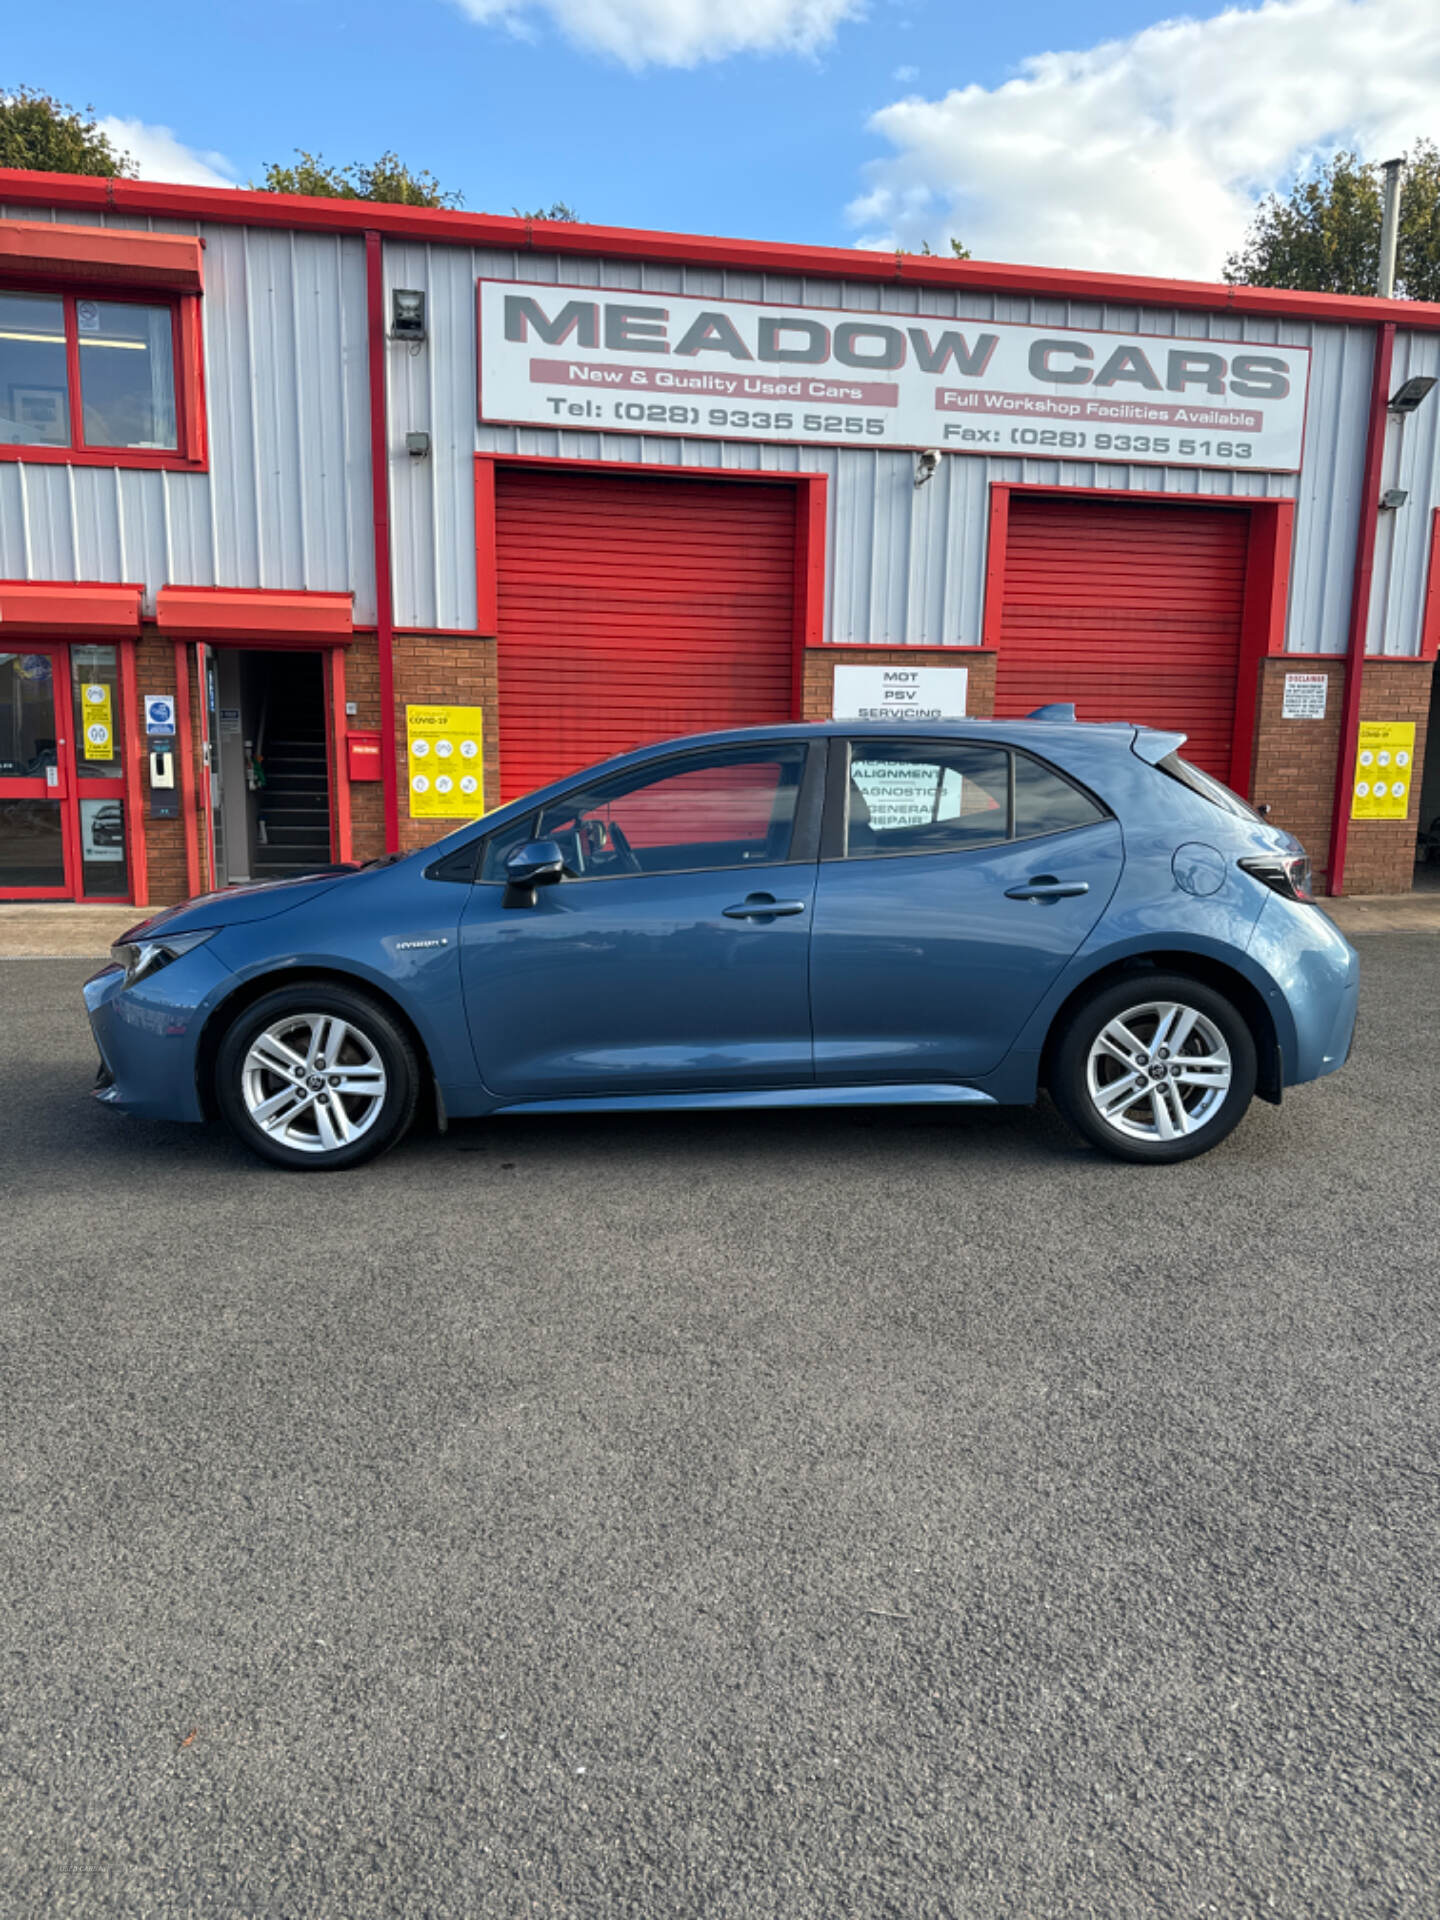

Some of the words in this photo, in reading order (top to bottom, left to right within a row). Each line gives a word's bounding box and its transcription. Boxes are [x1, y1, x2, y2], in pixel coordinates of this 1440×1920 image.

[504, 295, 999, 377] MEADOW
[1028, 338, 1290, 399] CARS
[569, 365, 623, 383] New
[630, 371, 649, 385] &
[655, 372, 737, 394] Quality
[744, 379, 800, 396] Used
[809, 383, 862, 400] Cars
[547, 397, 602, 418] Tel:
[614, 402, 699, 425] (028)
[708, 409, 793, 430] 9335
[803, 414, 885, 435] 5255
[944, 392, 978, 406] Full
[983, 394, 1080, 416] Workshop
[1086, 402, 1169, 421] Facilities
[1174, 408, 1255, 426] Available
[943, 424, 1000, 443] Fax:
[1011, 427, 1086, 449] (028)
[1094, 433, 1170, 453] 9335
[1179, 439, 1252, 459] 5163
[883, 672, 918, 682] MOT
[885, 690, 917, 700] PSV
[858, 708, 942, 718] SERVICING
[862, 787, 947, 797] AGNOSTICS
[871, 805, 932, 814] GENERA
